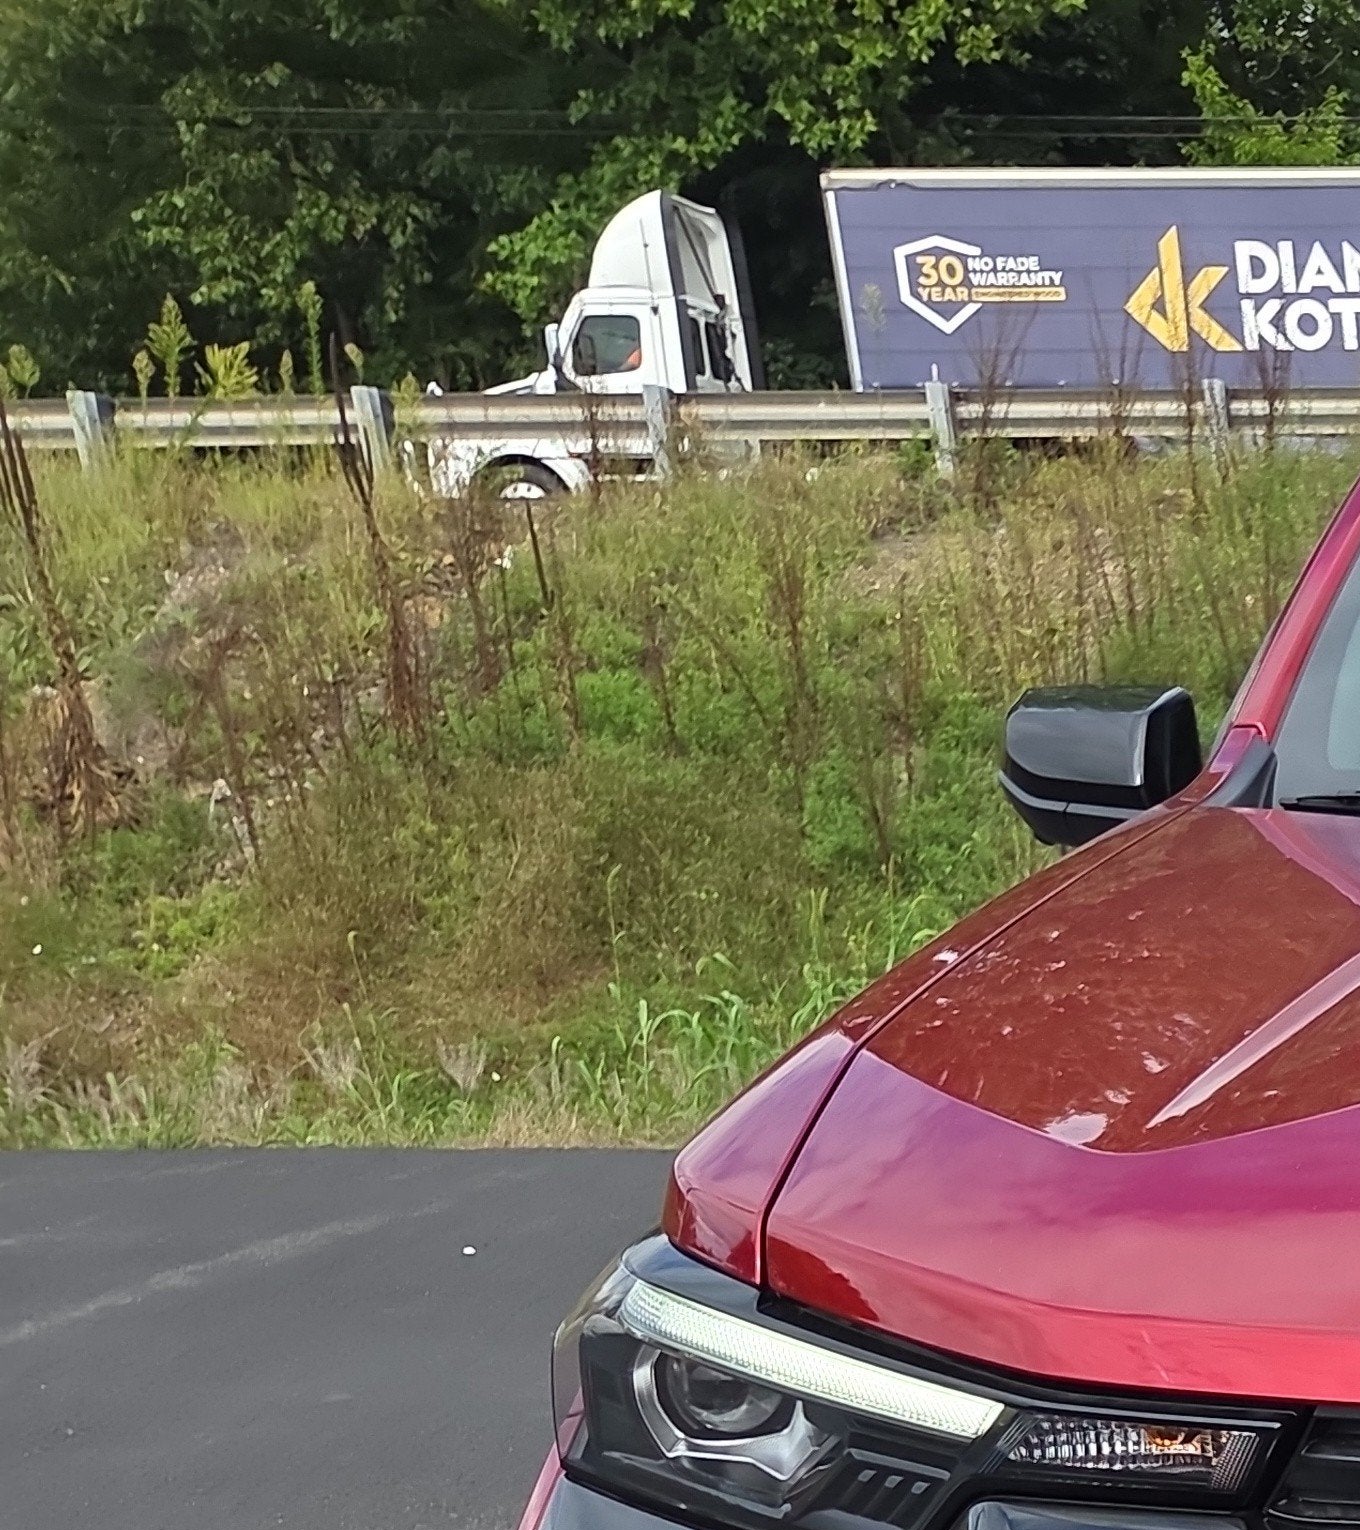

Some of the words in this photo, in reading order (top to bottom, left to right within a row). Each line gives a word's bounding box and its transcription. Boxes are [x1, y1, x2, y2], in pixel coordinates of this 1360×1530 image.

[915, 255, 965, 286] 30
[967, 256, 993, 271] NO
[996, 256, 1040, 271] FADE
[968, 271, 1063, 286] WARRANTY
[917, 287, 969, 302] YEAR
